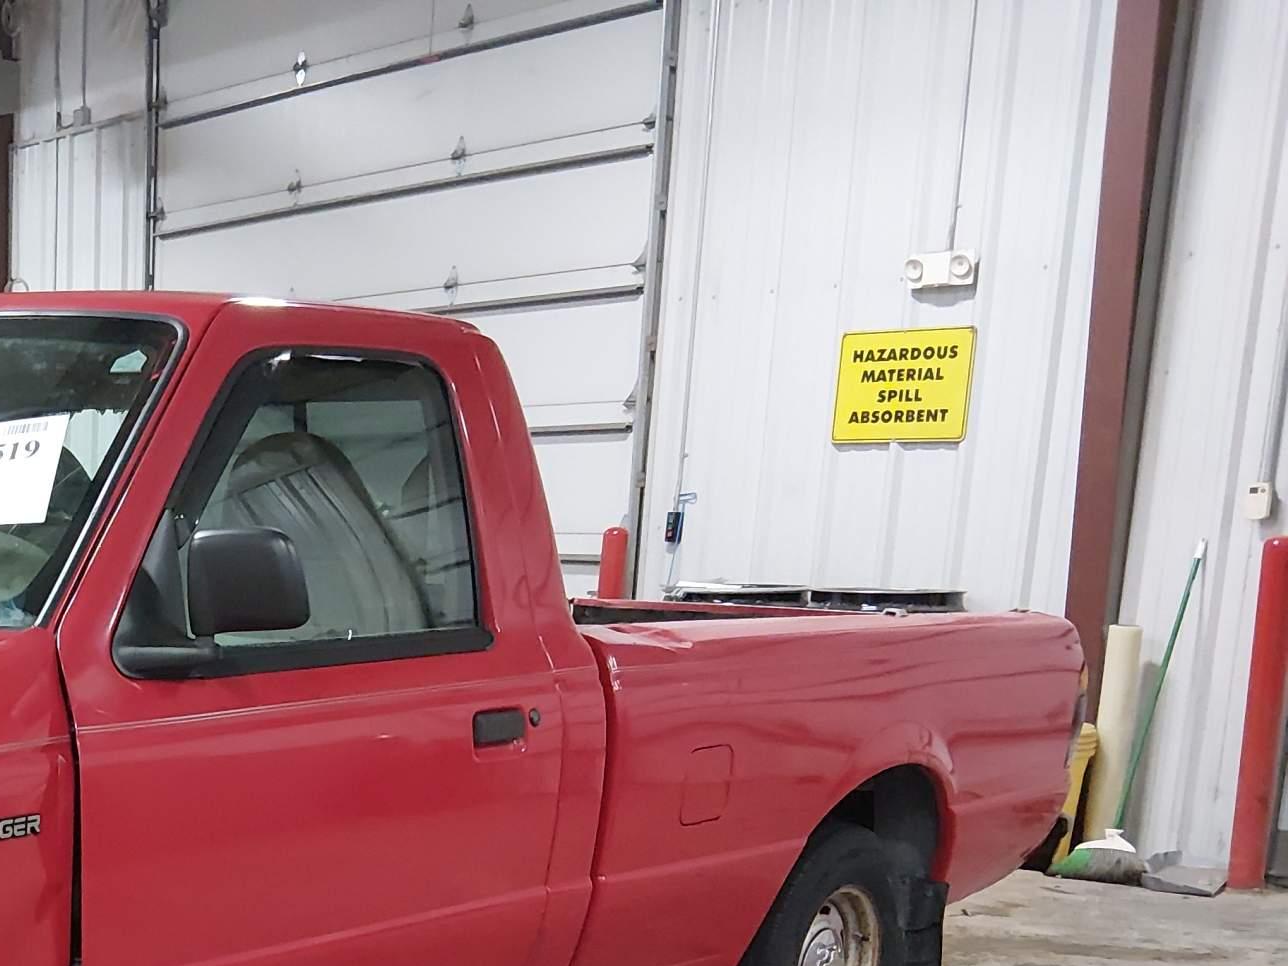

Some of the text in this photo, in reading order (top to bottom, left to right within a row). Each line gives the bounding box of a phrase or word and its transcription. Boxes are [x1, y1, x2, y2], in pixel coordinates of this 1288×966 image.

[852, 345, 959, 363] HAZARDOUS
[861, 367, 945, 383] MATERIAL
[877, 389, 923, 403] SPILL
[848, 408, 949, 424] ABSORBENT
